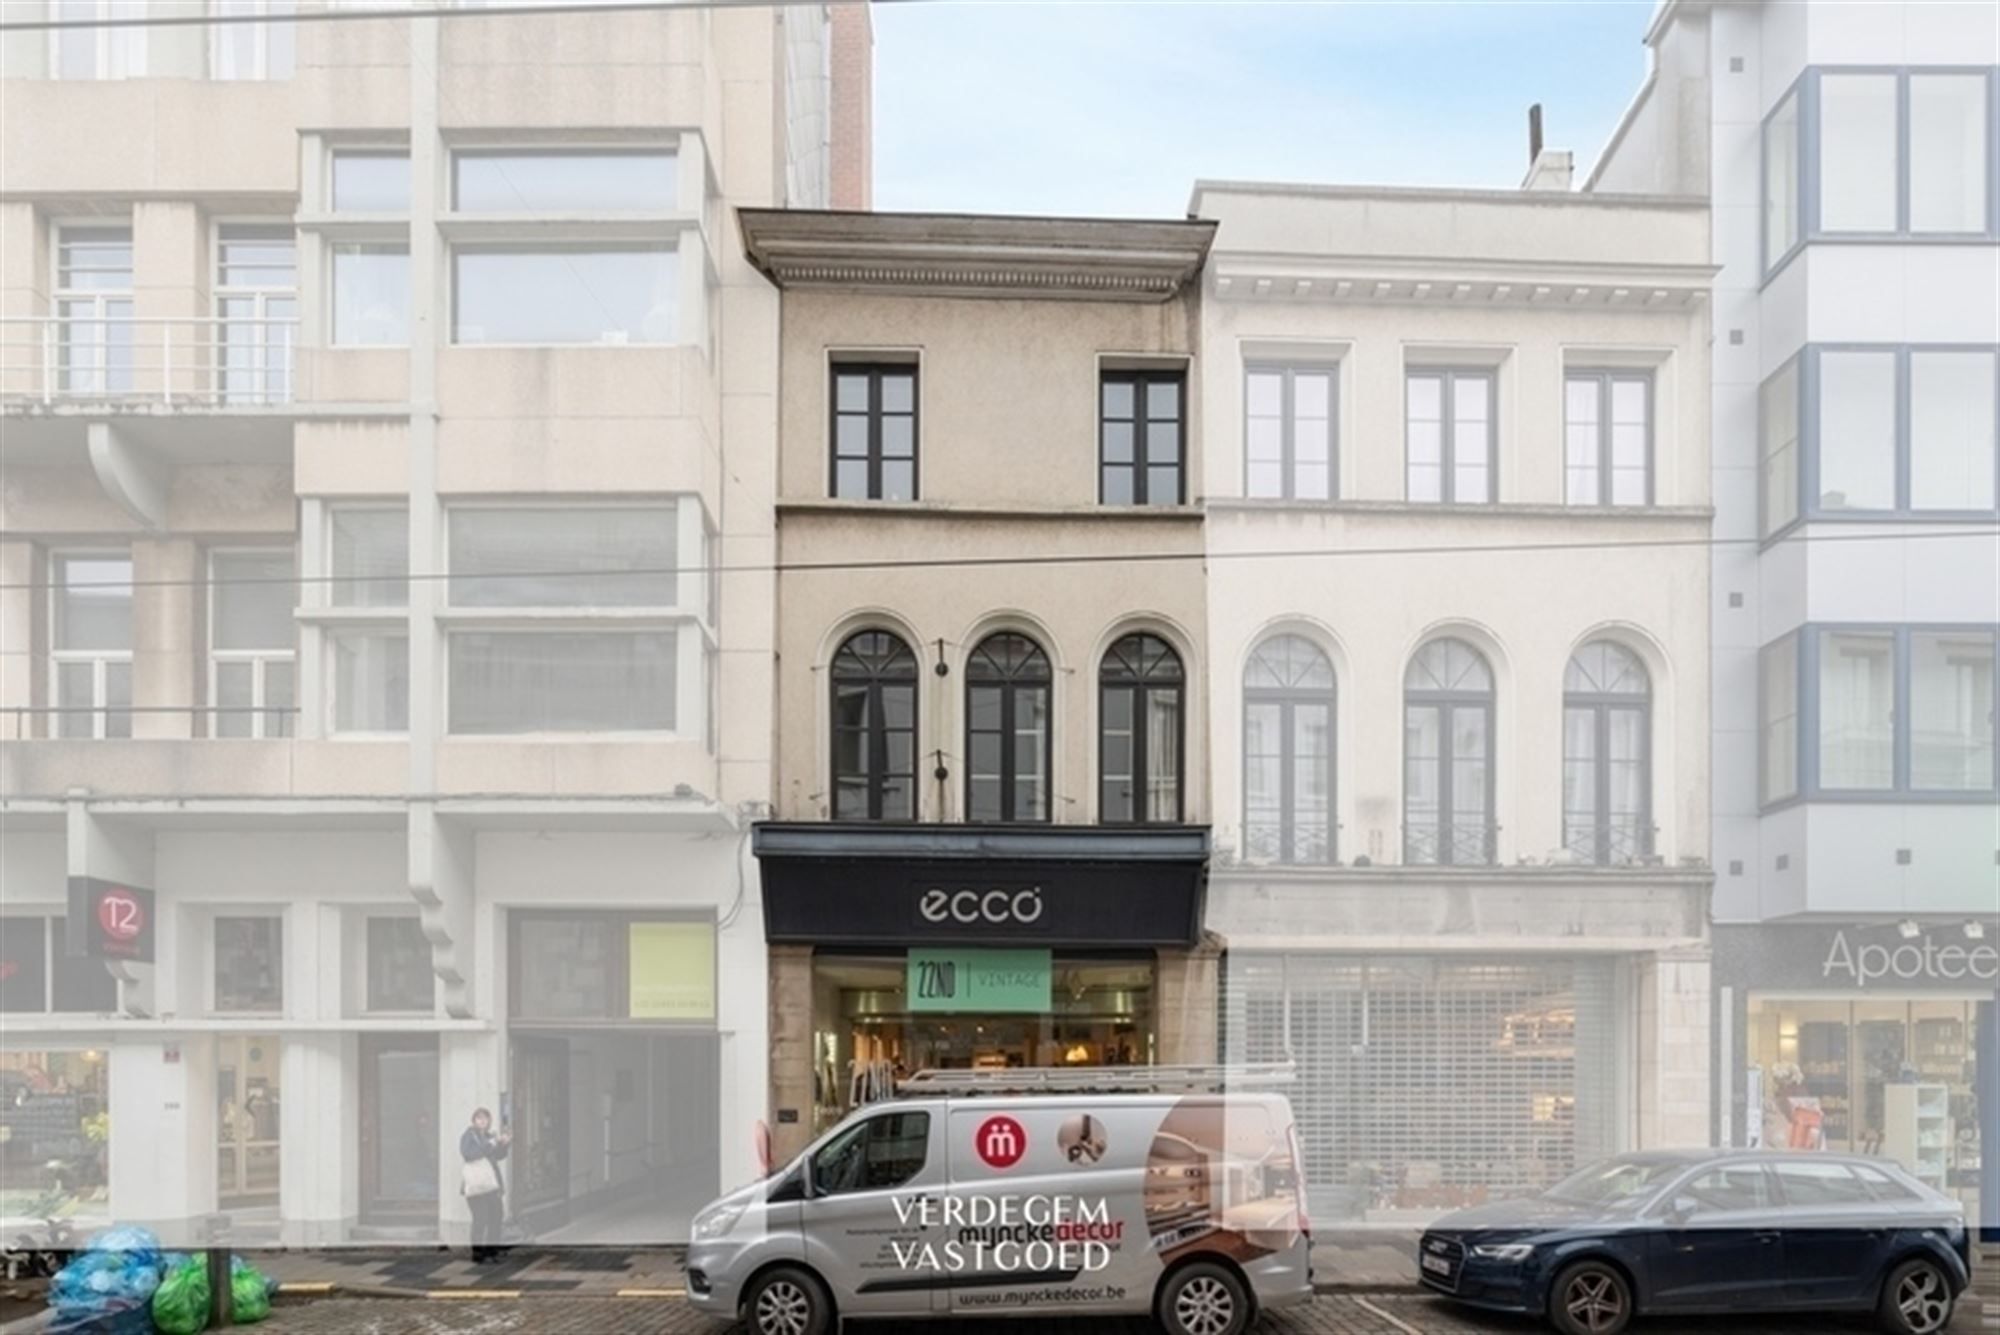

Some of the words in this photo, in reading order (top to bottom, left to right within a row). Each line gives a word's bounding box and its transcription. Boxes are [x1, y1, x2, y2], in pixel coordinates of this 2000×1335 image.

[1823, 930, 1998, 986] Apotee
[978, 971, 1041, 988] VINTAGE
[959, 1285, 1126, 1306] www.mynckedecor.be
